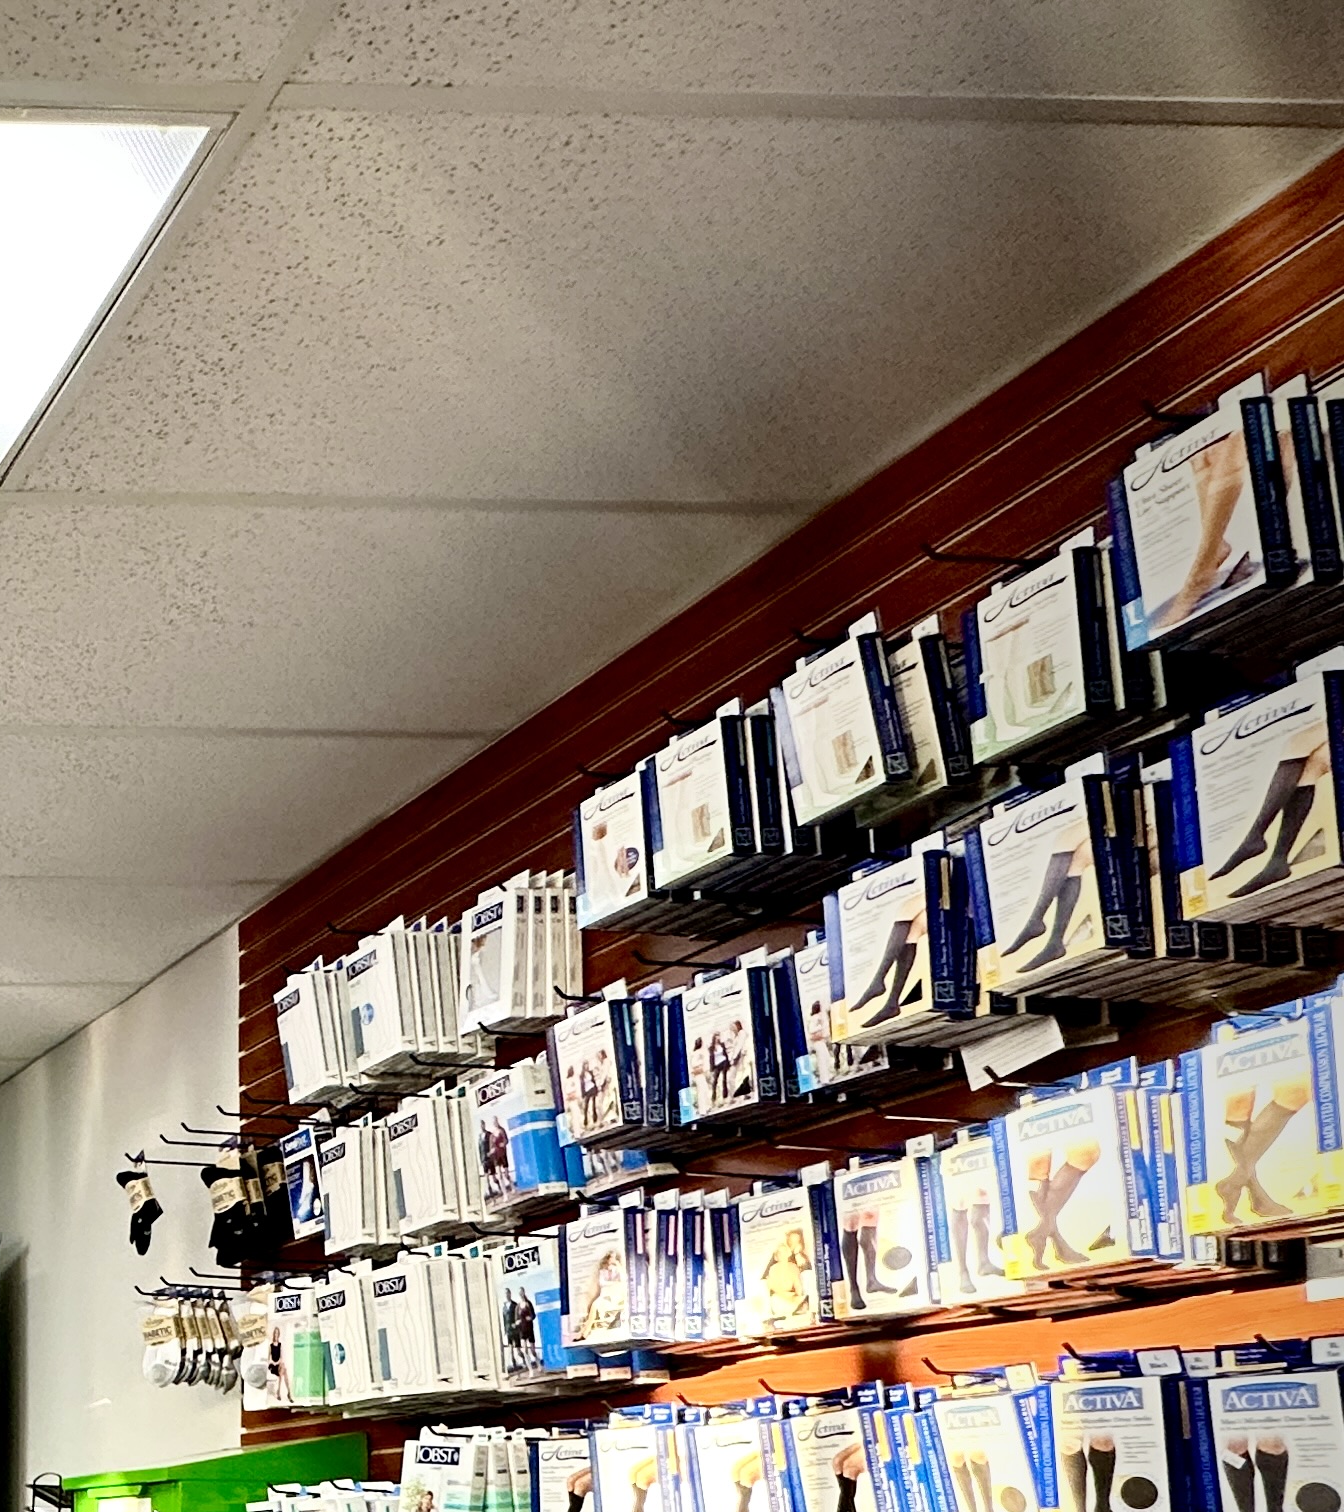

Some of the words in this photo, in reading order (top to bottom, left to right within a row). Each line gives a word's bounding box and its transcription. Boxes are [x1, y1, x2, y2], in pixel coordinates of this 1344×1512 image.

[1131, 428, 1232, 491] Activa
[984, 572, 1069, 623] Activa
[790, 657, 855, 699] Activa
[1201, 700, 1316, 755] Activa
[988, 800, 1077, 845] Activa
[844, 872, 916, 910] Activa
[473, 904, 502, 930] JOBST
[1218, 1037, 1304, 1076] ACTIVA
[479, 1077, 509, 1104] JOBST
[1019, 1105, 1090, 1140] ACTIVA
[844, 1176, 898, 1197] ACTIVA
[742, 1200, 802, 1223] Activa
[569, 1222, 624, 1242] Activa
[504, 1248, 538, 1272] JOBST
[375, 1277, 406, 1296] JOBST
[275, 1295, 301, 1311] JOBST
[1064, 1391, 1141, 1412] ACTIVA
[1224, 1387, 1316, 1411] ACTIVA
[798, 1420, 854, 1441] Activa
[417, 1447, 459, 1464] JOBST
[541, 1444, 588, 1461] Activa
